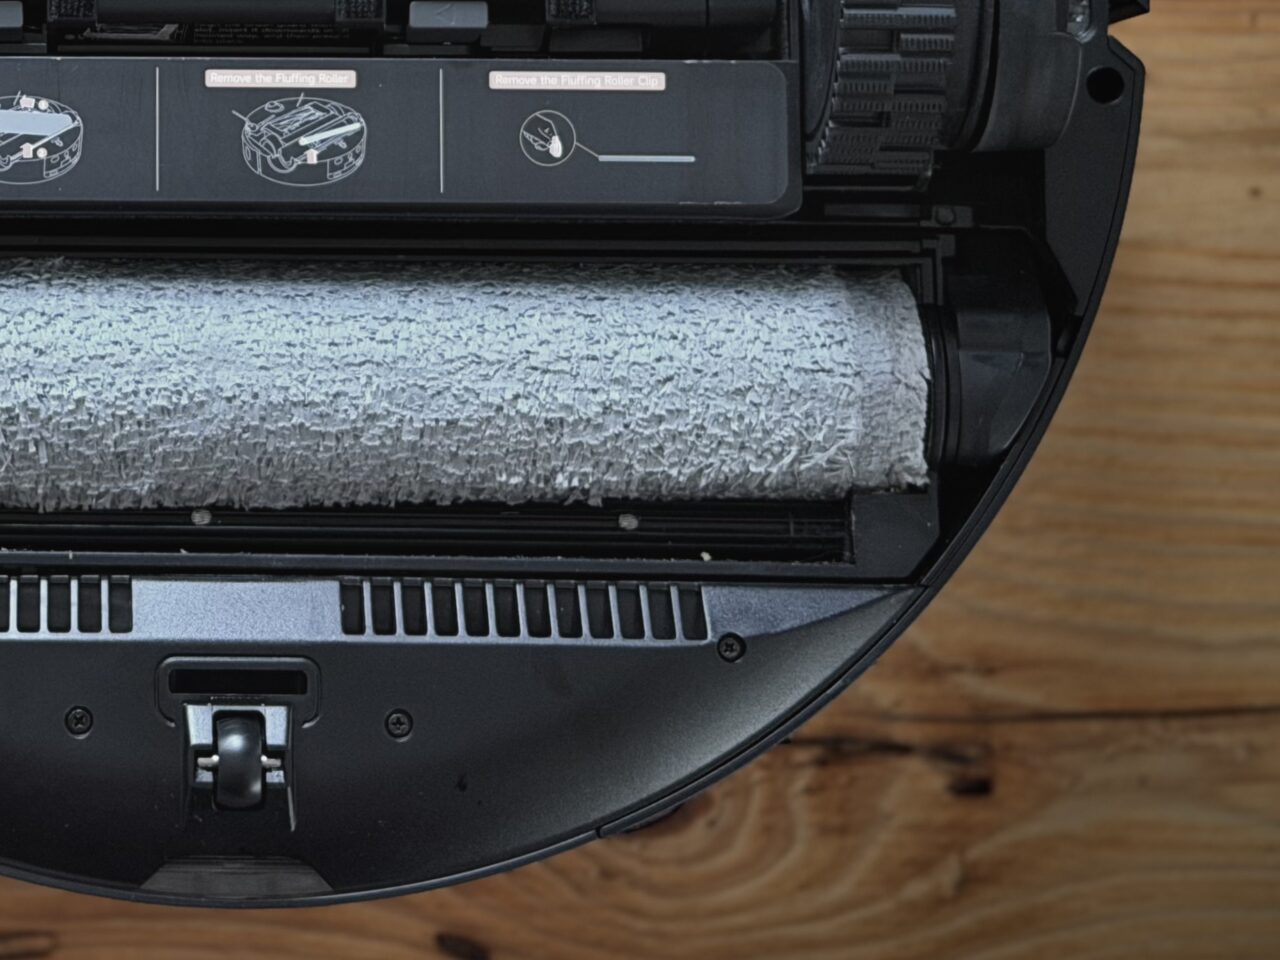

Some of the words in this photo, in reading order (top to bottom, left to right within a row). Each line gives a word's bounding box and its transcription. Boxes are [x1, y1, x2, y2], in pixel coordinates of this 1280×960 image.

[209, 72, 251, 83] Remove
[254, 72, 272, 83] the
[275, 72, 315, 86] Fluffing
[318, 72, 348, 83] Roller
[495, 73, 537, 85] Remove
[540, 74, 557, 85] the
[560, 74, 601, 88] Fluffing
[604, 75, 634, 86] Roller
[637, 75, 658, 88] Clip
